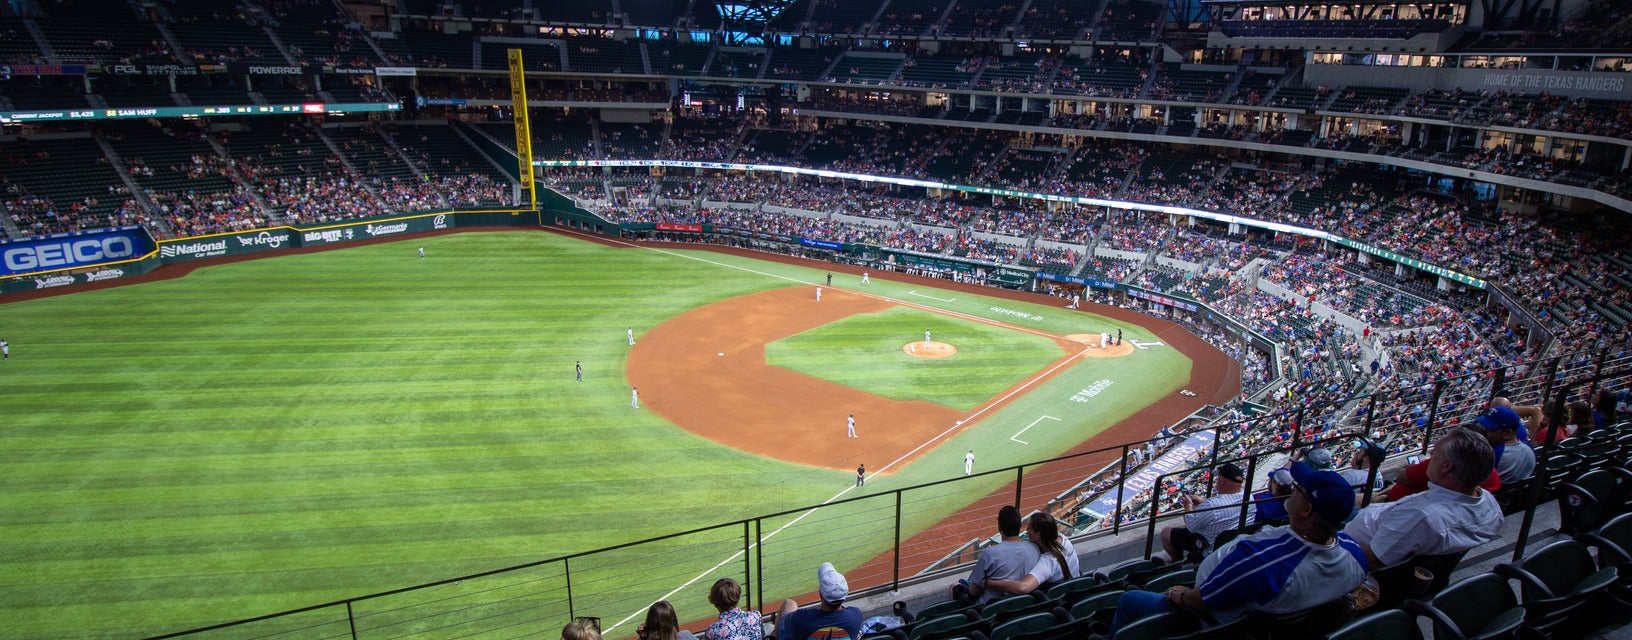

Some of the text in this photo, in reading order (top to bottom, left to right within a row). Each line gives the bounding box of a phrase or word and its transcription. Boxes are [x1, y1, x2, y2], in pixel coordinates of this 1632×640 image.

[114, 65, 141, 73] PGL
[249, 66, 303, 75] POWERADE
[1484, 74, 1625, 92] HOME OF THE TEXAS RANGERS
[118, 109, 135, 117] SAM
[254, 231, 289, 248] Kroger
[321, 230, 342, 239] BITE
[4, 236, 133, 271] GEICO
[176, 240, 226, 255] National
[1124, 444, 1196, 492] TEXAS RANGERS
